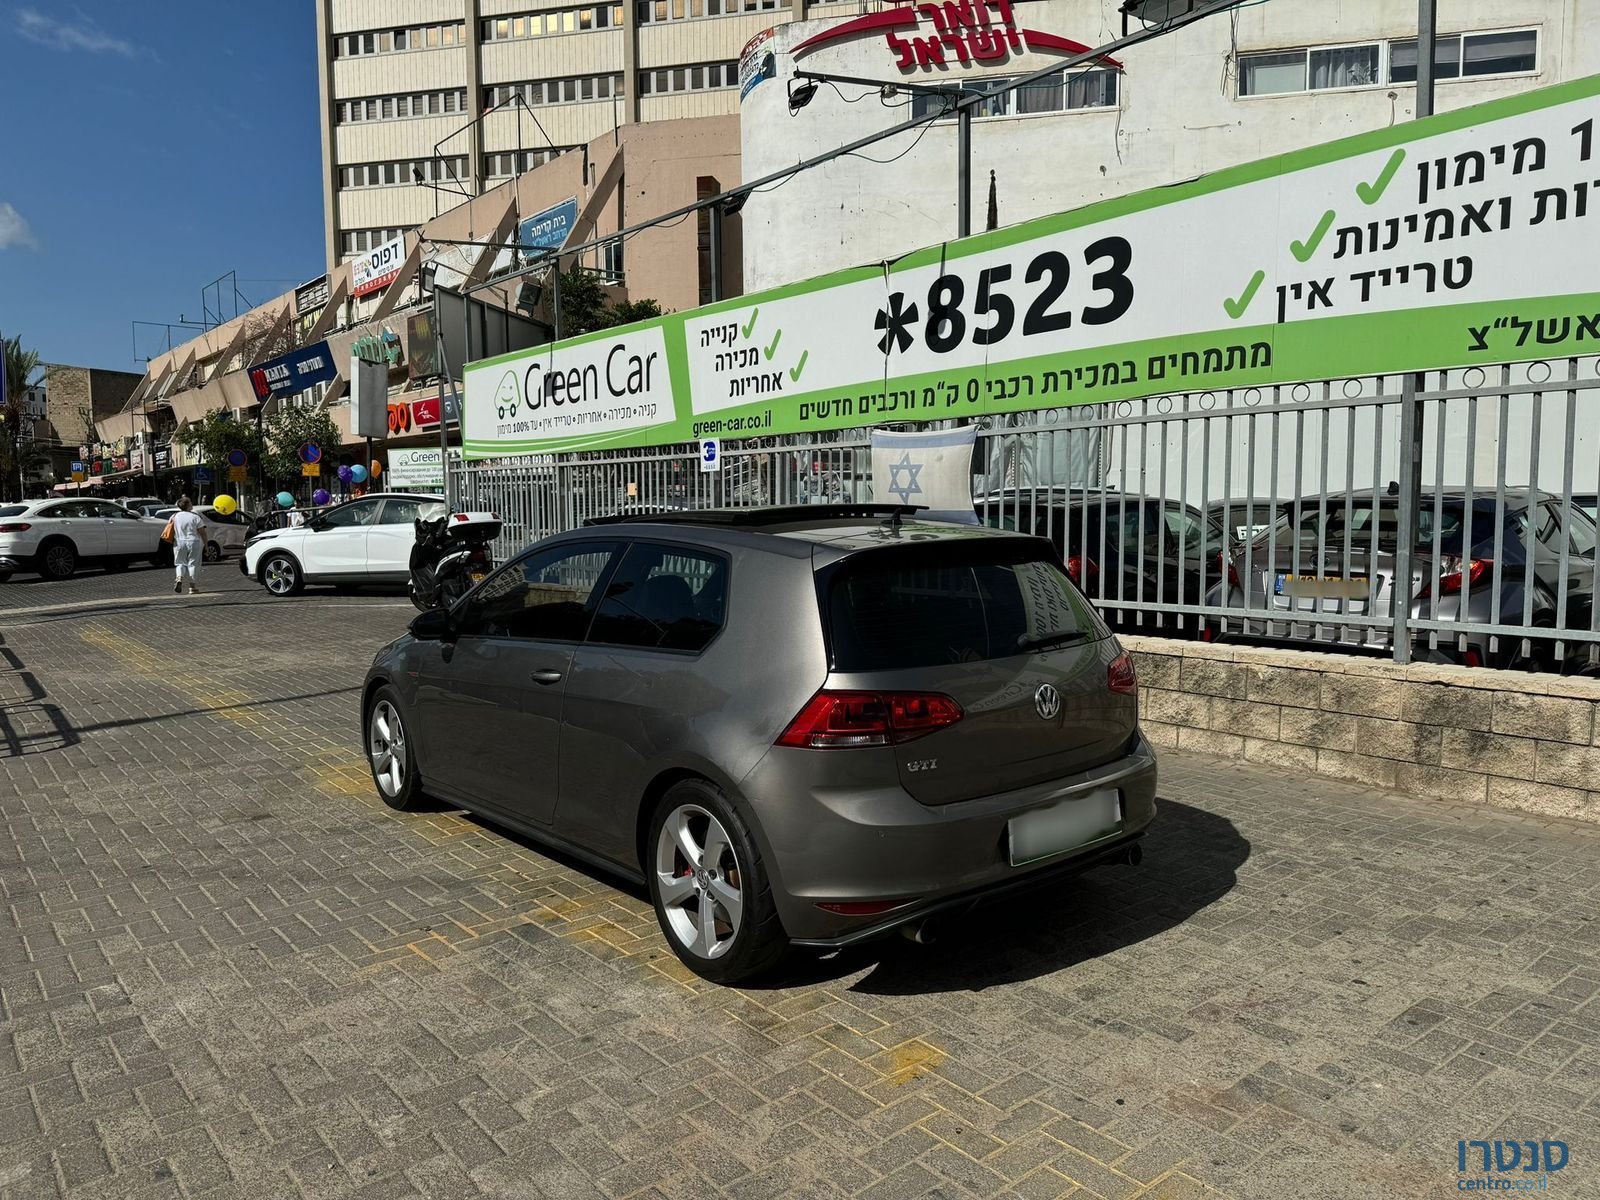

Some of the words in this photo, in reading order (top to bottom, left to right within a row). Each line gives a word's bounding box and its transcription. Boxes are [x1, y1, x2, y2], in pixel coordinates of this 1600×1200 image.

[886, 28, 1019, 68] ישראל
[1417, 136, 1547, 204] מימון
[531, 220, 552, 238] קדימה
[553, 215, 567, 229] בית
[1333, 197, 1512, 260] ואמינות
[371, 243, 399, 270] דפוס
[1350, 255, 1473, 303] טרייד
[1276, 276, 1335, 324] אין
[701, 323, 738, 348] קנייה
[715, 346, 759, 372] מכירה
[1146, 341, 1272, 380] מתמחים
[525, 363, 598, 410] Green
[606, 344, 657, 397] Car
[729, 372, 784, 398] אחריות
[985, 373, 1034, 401] רכבי
[1041, 360, 1138, 393] במכירת
[858, 388, 915, 414] ורכבים
[966, 379, 980, 403] 0
[554, 415, 572, 427] טרייד
[577, 411, 602, 425] אחריות
[609, 407, 631, 421] מכירה
[638, 403, 657, 419] קניה
[799, 398, 854, 422] חדשים
[513, 421, 530, 433] 100%
[693, 410, 772, 438] green-car.co.il
[411, 451, 440, 463] Green
[907, 758, 938, 772] GTI
